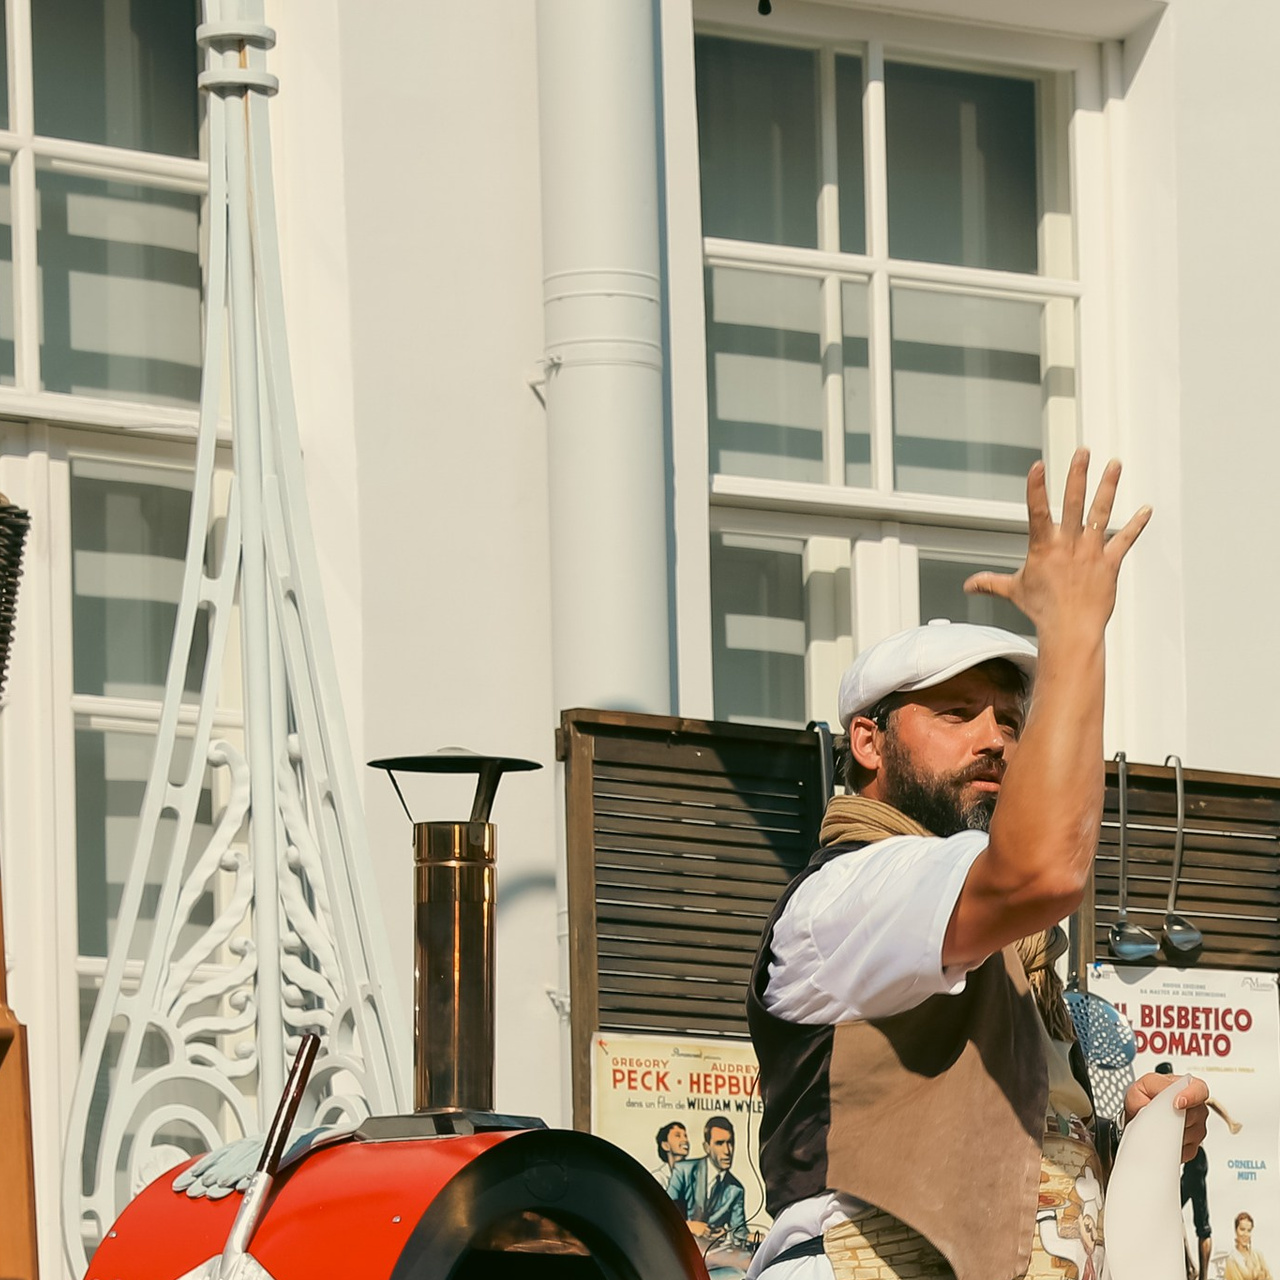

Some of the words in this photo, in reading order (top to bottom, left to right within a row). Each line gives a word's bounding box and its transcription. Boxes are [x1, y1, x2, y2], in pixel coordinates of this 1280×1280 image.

[1140, 1004, 1253, 1032] BISBETICO
[1133, 1030, 1231, 1057] DOMATO
[612, 1057, 669, 1069] GREGORY
[710, 1062, 760, 1074] AUDREY
[612, 1068, 671, 1092] PECK
[625, 1097, 644, 1108] dans
[645, 1101, 656, 1109] un
[675, 1100, 686, 1110] de
[687, 1097, 731, 1112] WILLIAM
[1227, 1159, 1266, 1170] ORNELLA
[1237, 1171, 1257, 1181] MUTI
